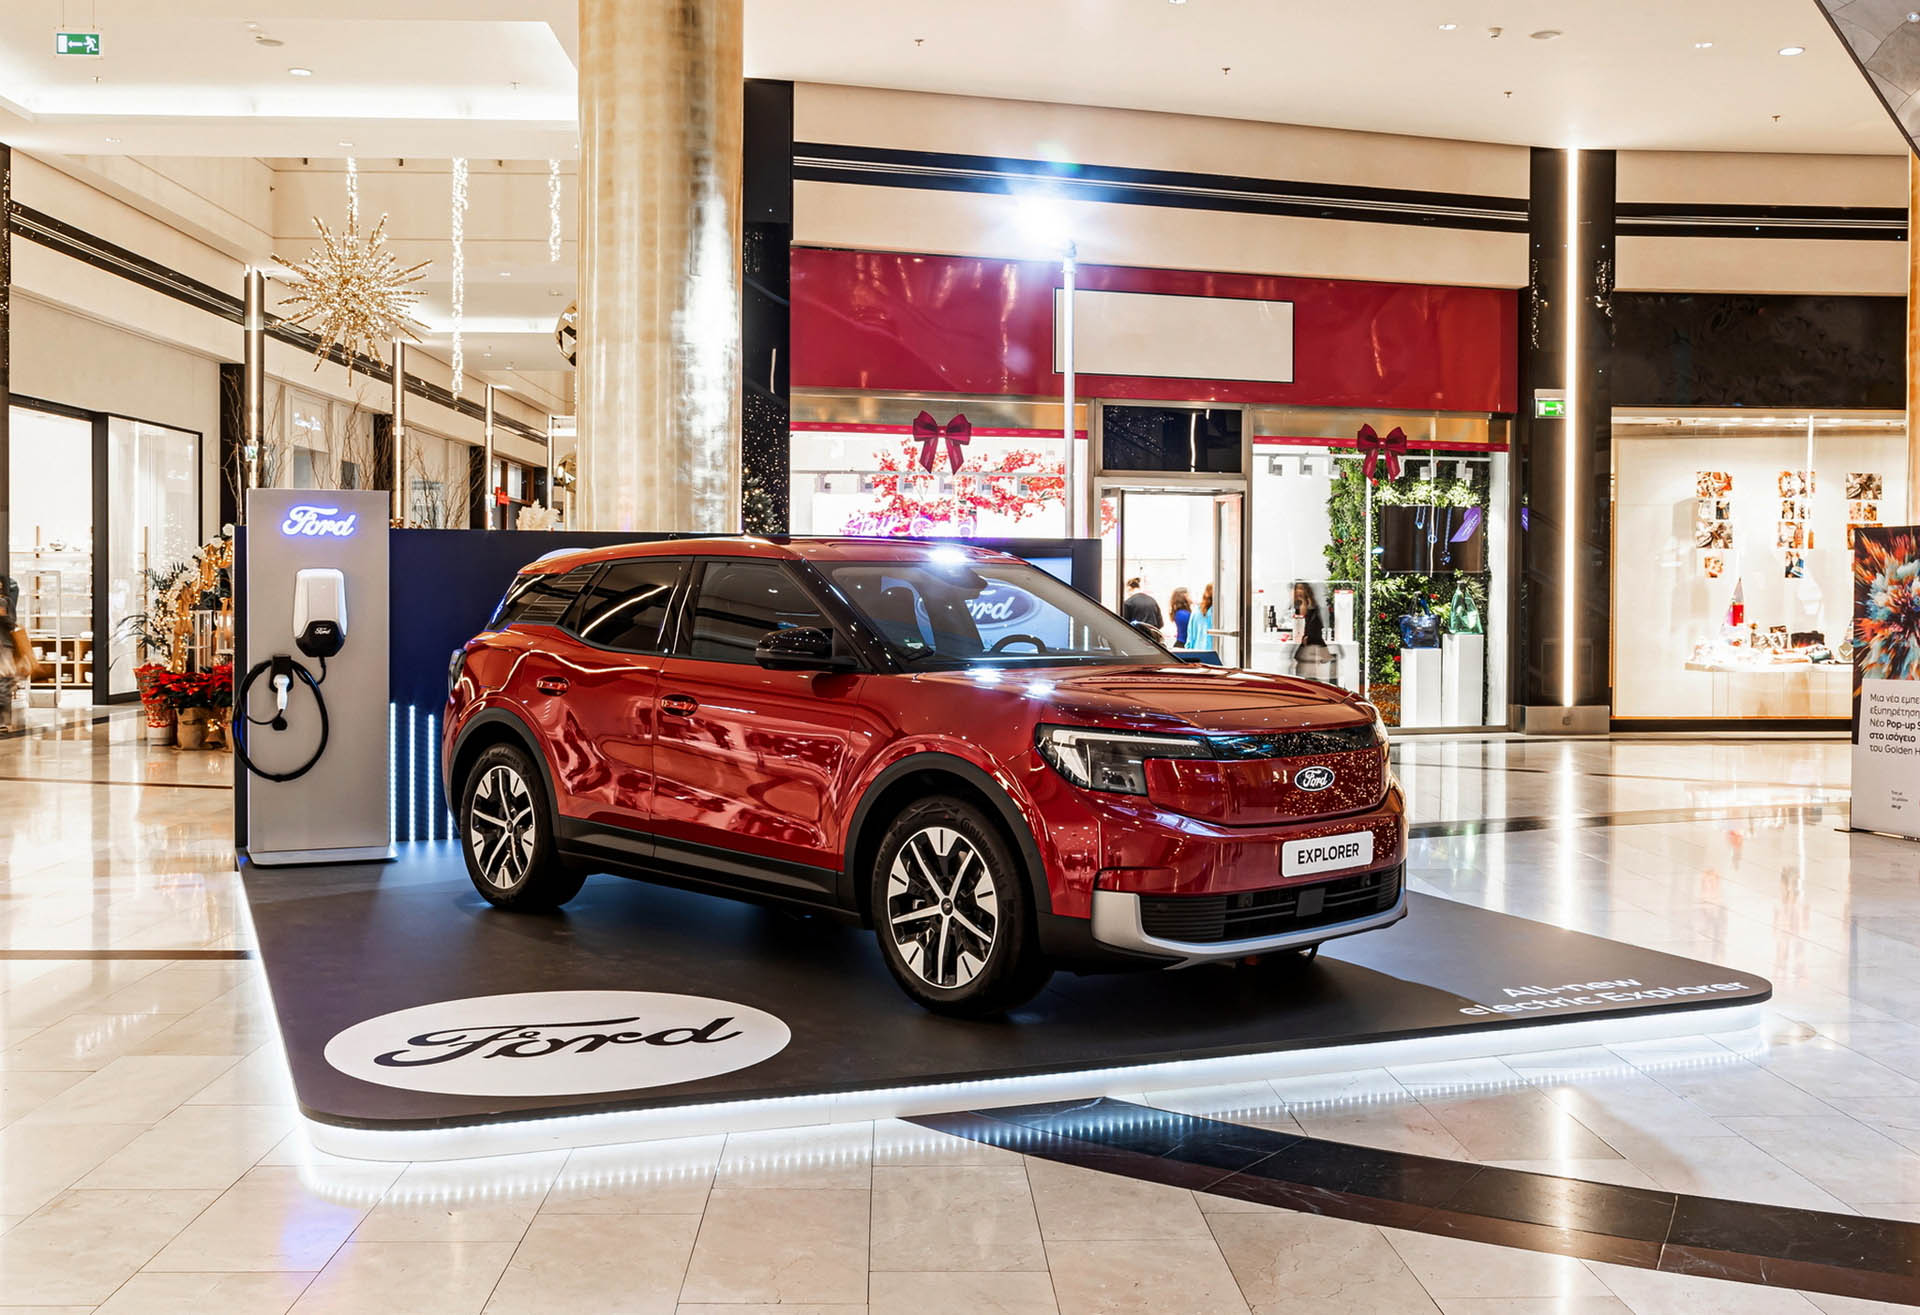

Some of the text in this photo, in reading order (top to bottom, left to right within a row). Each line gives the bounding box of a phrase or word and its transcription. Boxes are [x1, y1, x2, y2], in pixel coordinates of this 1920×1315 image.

[282, 505, 356, 536] Ford
[1887, 719, 1916, 731] Pop-up
[1869, 732, 1916, 743] στο ισόγειο
[1870, 744, 1883, 753] του
[1885, 744, 1913, 755] Golden
[1302, 769, 1328, 788] Ford
[1297, 842, 1360, 865] EXPLORER
[1502, 978, 1642, 997] All-new
[1459, 982, 1749, 1015] electric Explorer
[373, 1016, 743, 1067] Ford
